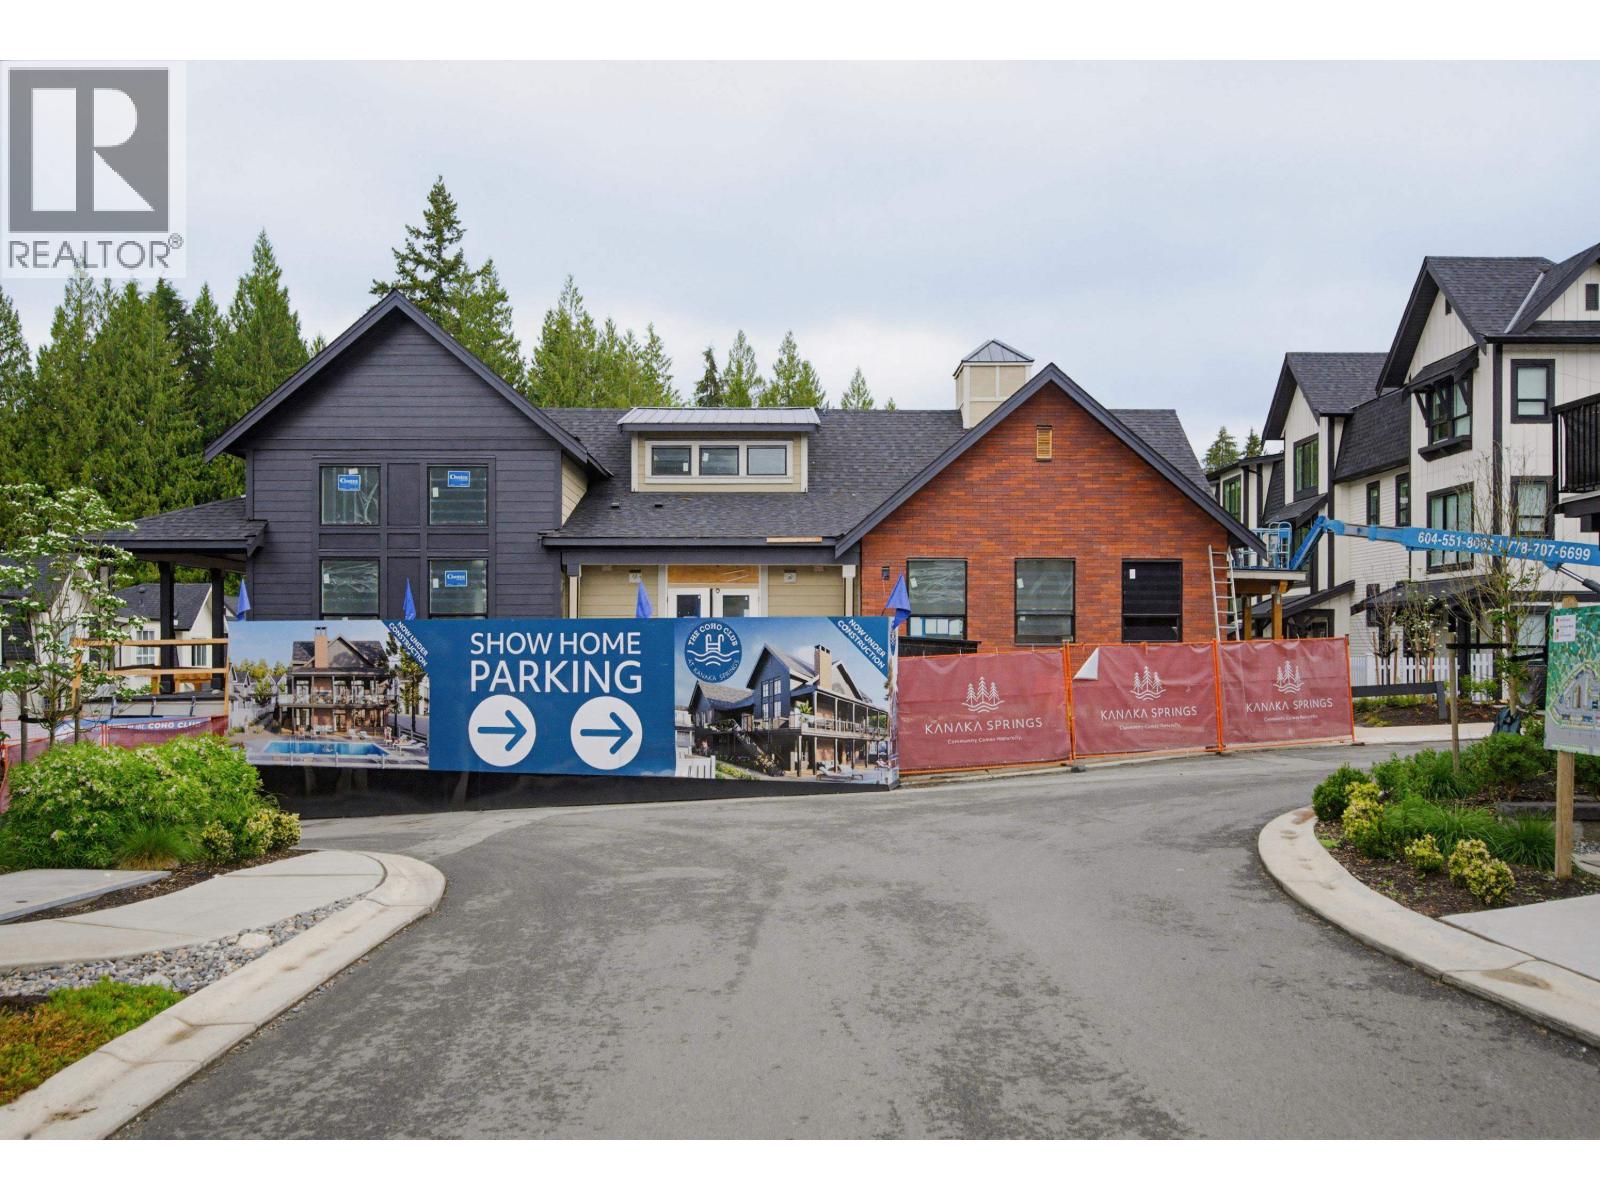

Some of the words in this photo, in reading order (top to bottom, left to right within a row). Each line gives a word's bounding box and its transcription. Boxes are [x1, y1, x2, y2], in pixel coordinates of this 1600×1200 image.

[388, 622, 428, 668] CONSTRUCTION
[397, 621, 412, 637] NOW
[409, 635, 429, 657] UNDER
[470, 632, 553, 655] SHOW
[559, 631, 642, 655] HOME
[688, 630, 700, 646] THE
[699, 622, 723, 633] COHO
[723, 627, 738, 647] CLUB
[837, 620, 886, 669] CONSTRUCTION
[848, 619, 866, 636] NOW
[864, 634, 886, 657] UNDER
[470, 660, 642, 694] PARKING
[1100, 708, 1148, 721] KANAKA
[1151, 705, 1197, 718] SPRINGS
[1246, 701, 1290, 713] KANAKA
[1293, 697, 1333, 710] SPRINGS
[148, 722, 175, 730] COHO
[925, 721, 983, 735] KANAKA
[986, 717, 1043, 731] SPRINGS
